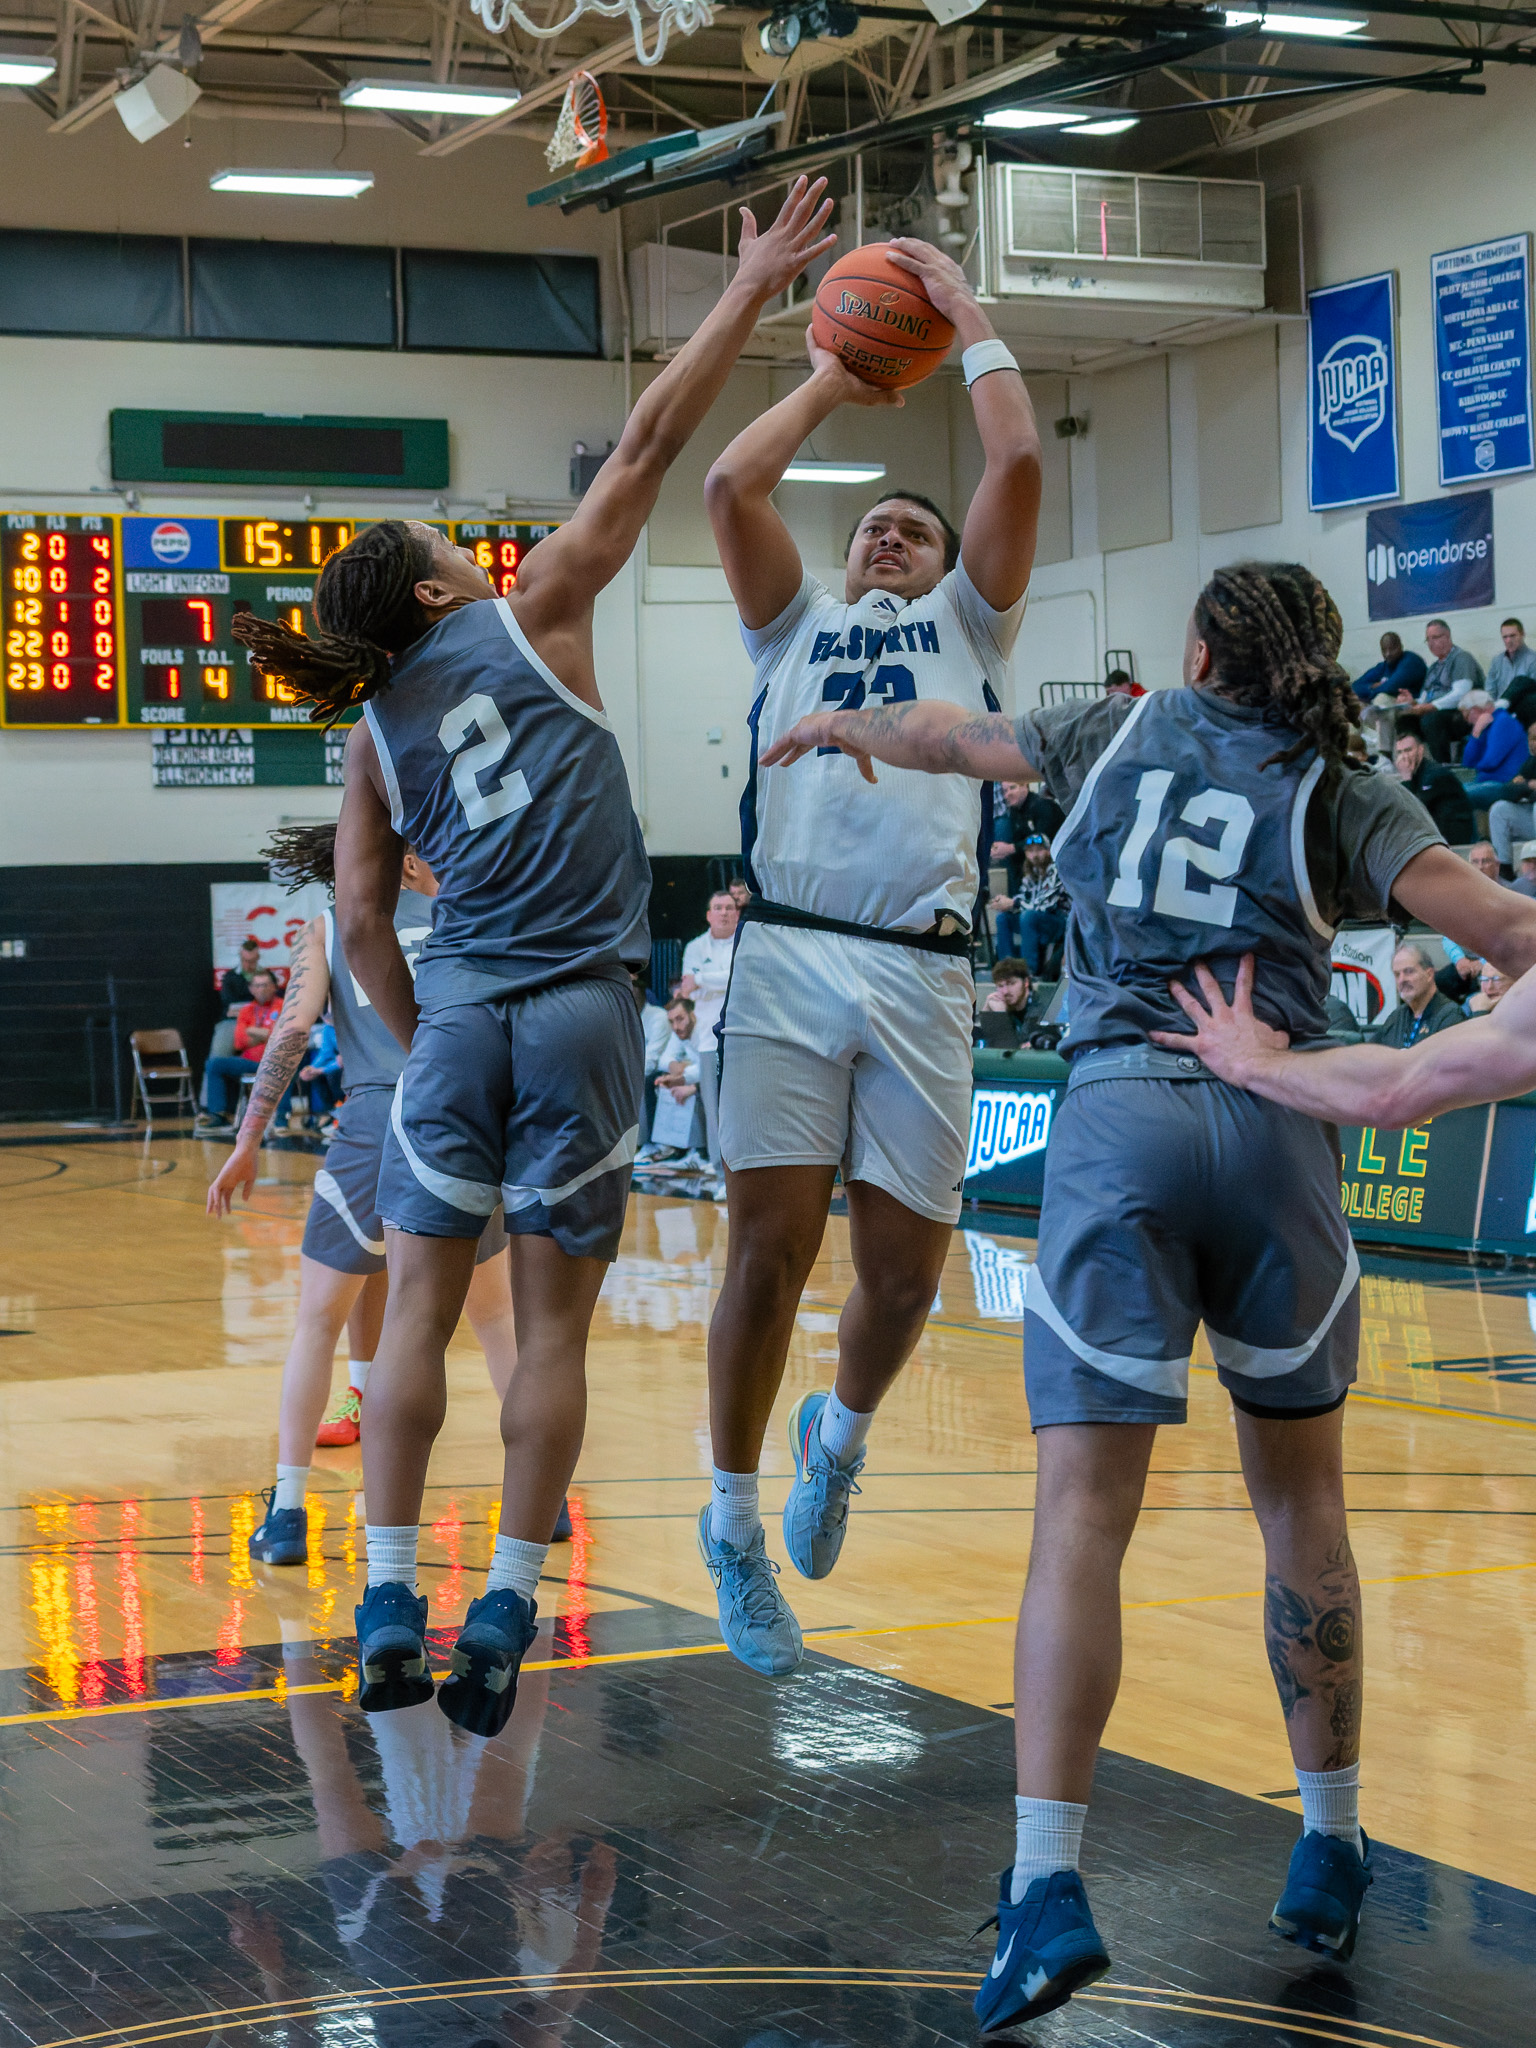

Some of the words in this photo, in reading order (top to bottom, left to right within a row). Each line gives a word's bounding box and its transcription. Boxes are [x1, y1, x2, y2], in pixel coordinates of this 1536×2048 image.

[836, 290, 932, 341] SPALDING
[832, 333, 913, 370] LEGACY
[1321, 356, 1384, 416] NJCAA
[22, 533, 41, 561] 2
[48, 533, 66, 561] 0
[92, 536, 111, 560] 4
[153, 538, 188, 547] PEPSI
[476, 541, 494, 568] 6
[501, 543, 517, 568] 0
[1397, 538, 1488, 576] opendorse
[14, 565, 42, 594] 10
[49, 566, 68, 594] 0
[93, 566, 111, 594] 2
[132, 574, 168, 592] LIGHT
[172, 575, 228, 594] UNIFORM
[266, 586, 314, 602] PERIOD
[15, 597, 43, 625] 12
[59, 600, 69, 623] 1
[94, 599, 112, 625] 0
[187, 600, 213, 643] 7
[7, 630, 44, 658] 22
[51, 631, 70, 658] 0
[95, 631, 113, 658] 0
[140, 649, 184, 665] FOULS
[7, 662, 45, 690] 23
[52, 663, 71, 690] 0
[96, 663, 114, 690] 2
[168, 667, 180, 698] 1
[204, 667, 229, 699] 4
[140, 707, 186, 723] SCORE
[270, 707, 313, 723] MATC
[164, 728, 244, 745] PIMA
[437, 692, 534, 831] 2
[1106, 768, 1256, 929] 12
[246, 906, 306, 949] Ca
[968, 1099, 1047, 1168] NJCAA
[1341, 1118, 1433, 1178] LE
[1341, 1181, 1426, 1224] OLLEGE
